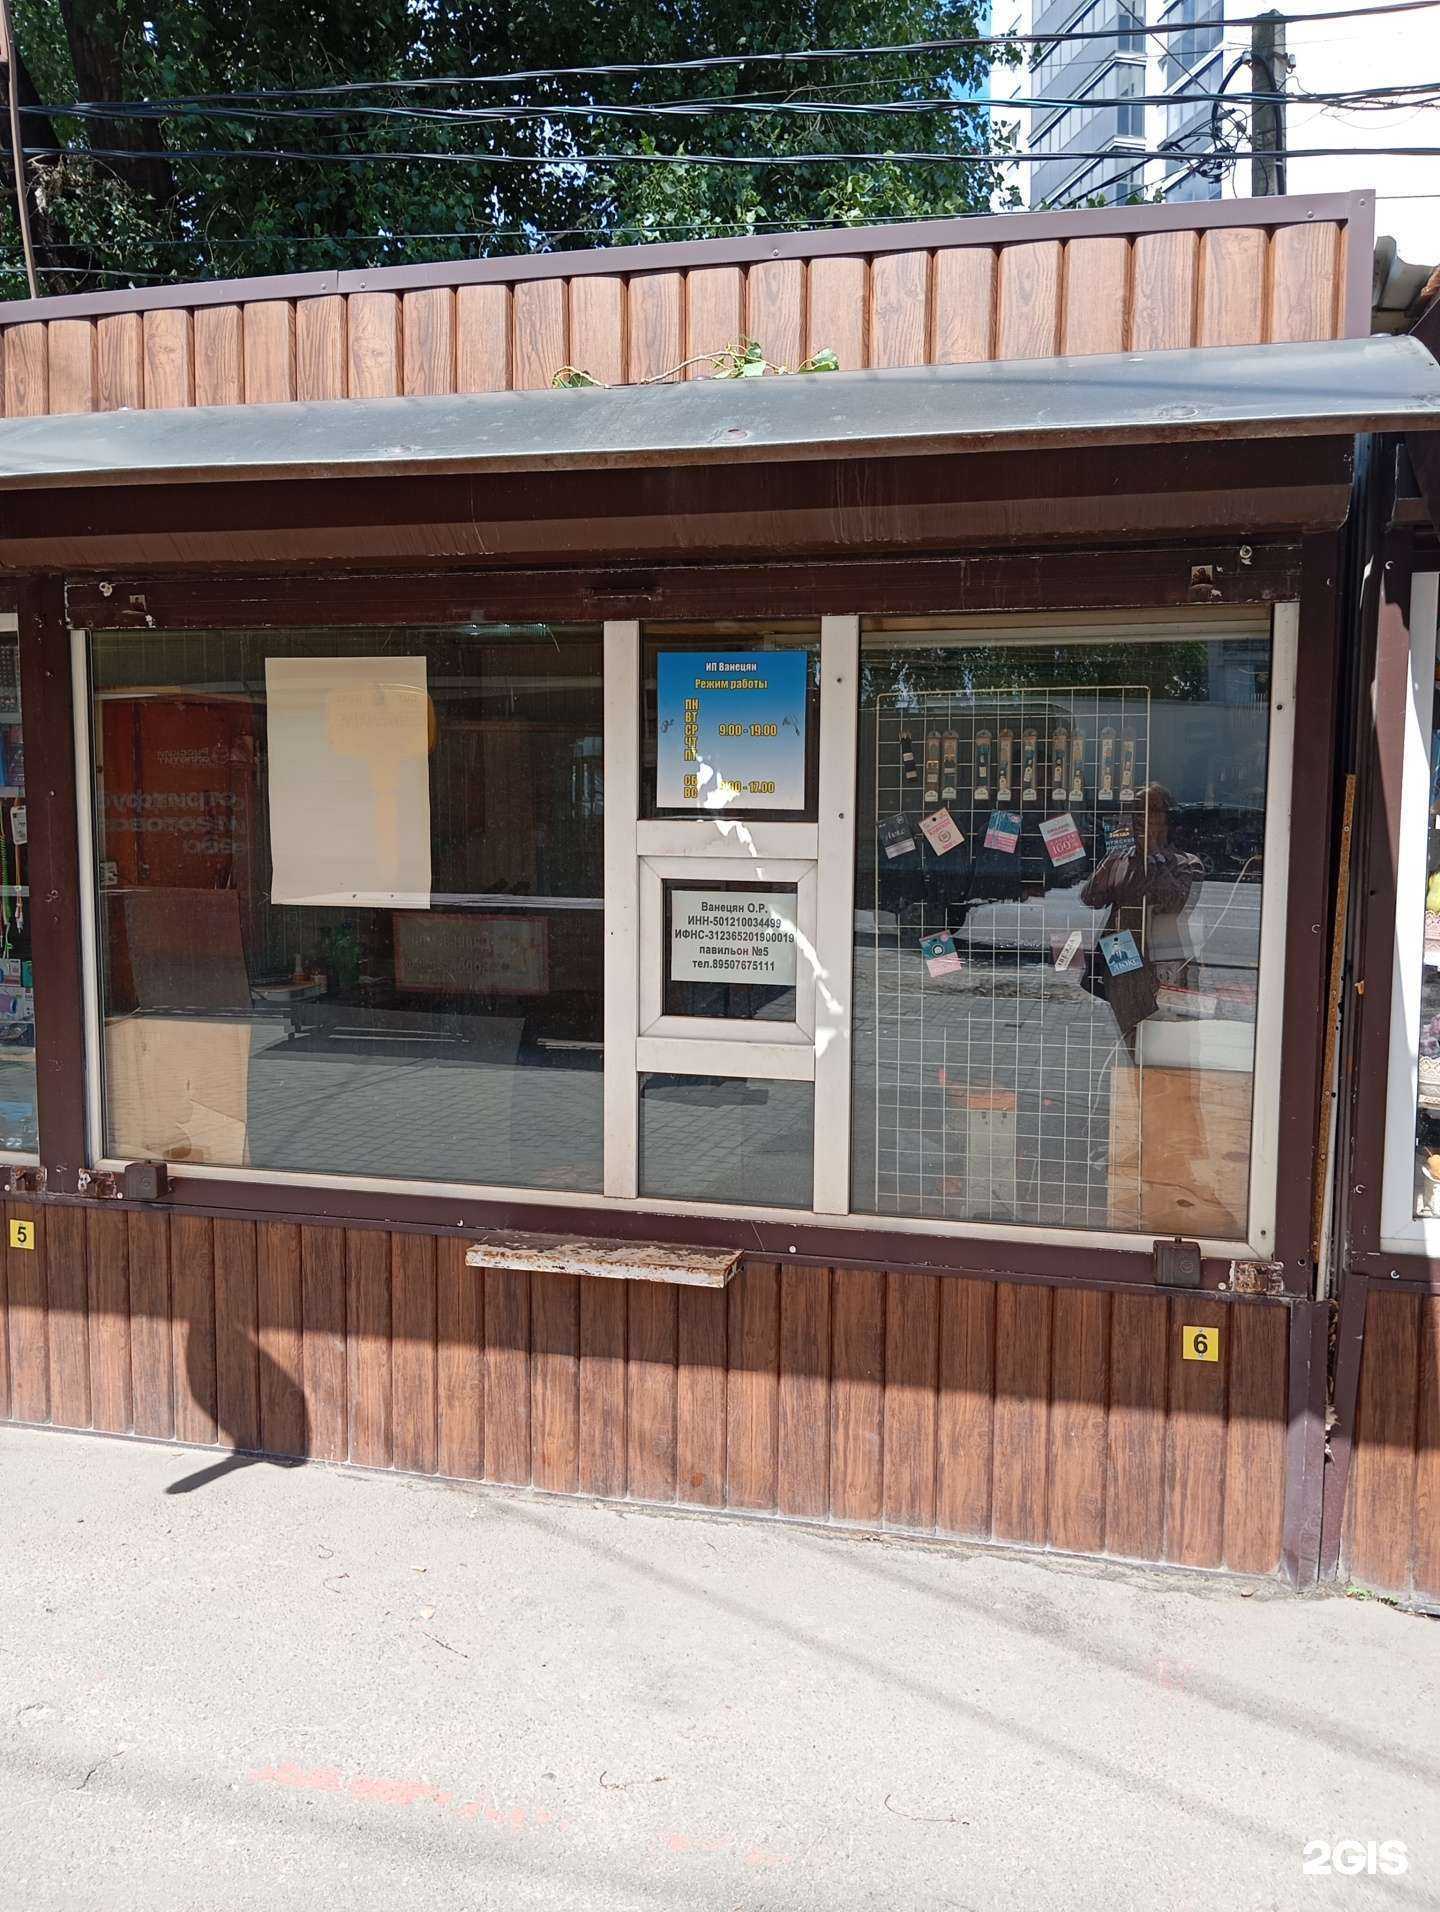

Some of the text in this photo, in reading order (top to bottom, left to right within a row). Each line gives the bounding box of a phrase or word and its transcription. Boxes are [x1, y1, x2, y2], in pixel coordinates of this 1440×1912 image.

[705, 662, 757, 673] ИП Ванецян
[695, 678, 769, 690] Режим работы
[684, 698, 699, 710] ПН
[684, 711, 698, 723] ВТ
[684, 724, 699, 735] СР
[750, 724, 778, 736] 19.00
[684, 736, 698, 748] ЧТ
[684, 749, 698, 761] ПТ
[684, 774, 698, 787] СБ
[684, 787, 698, 799] ВС
[749, 781, 776, 793] 17.00
[701, 901, 768, 914] Ванецян О.Р.
[687, 915, 782, 929] ИНН-501210034499
[674, 929, 795, 943] ИФНС-312365201900019
[699, 946, 769, 957] павильон №5
[692, 959, 775, 972] тел.89507675111
[17, 1226, 27, 1243] 5
[1193, 1333, 1208, 1354] 6
